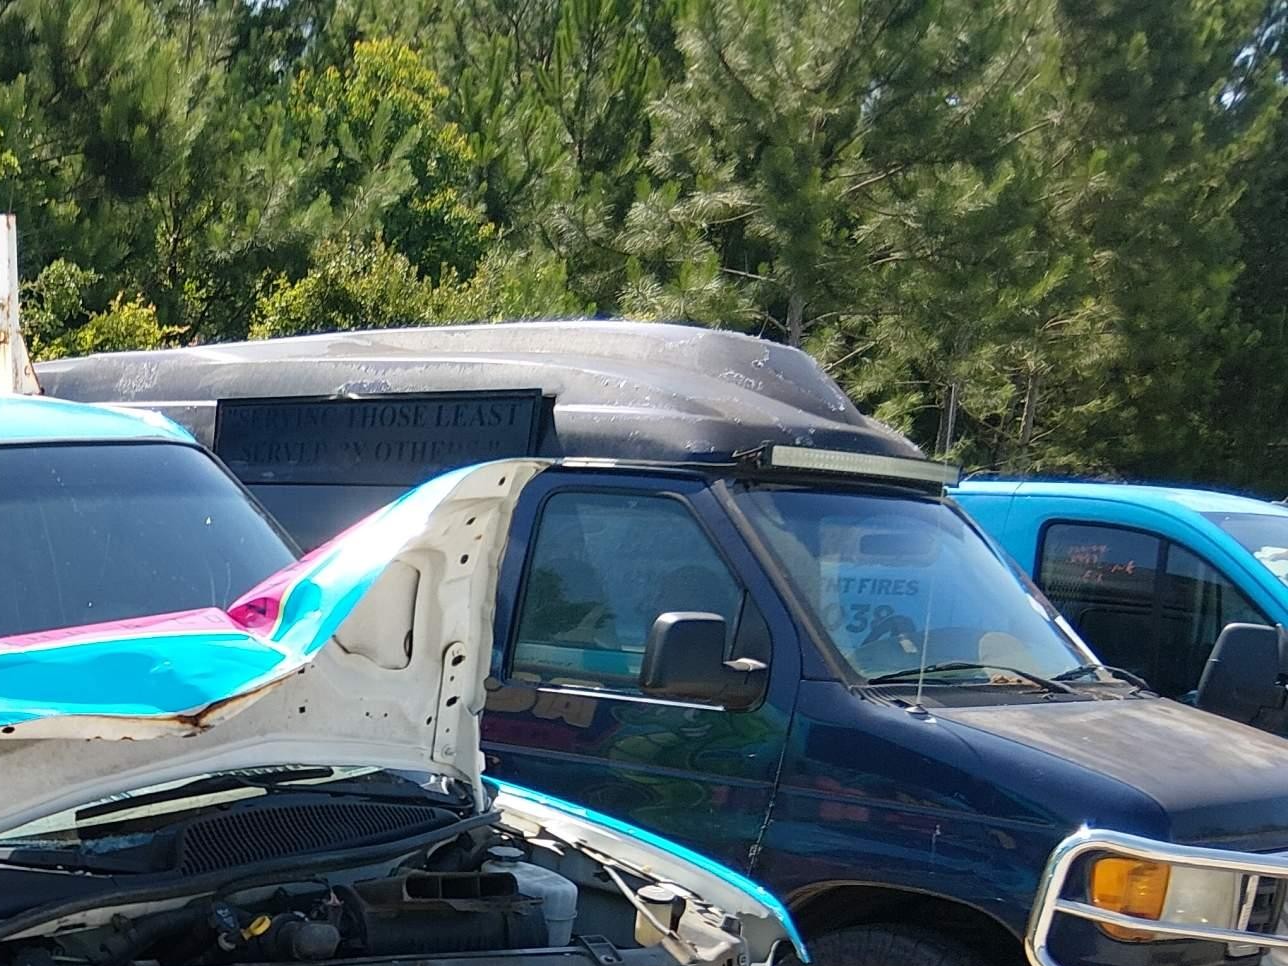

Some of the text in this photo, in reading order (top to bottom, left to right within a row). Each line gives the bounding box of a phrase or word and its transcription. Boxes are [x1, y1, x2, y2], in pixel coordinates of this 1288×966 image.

[346, 405, 426, 428] THOSE
[435, 403, 523, 428] LEAST
[857, 578, 920, 596] FIRES
